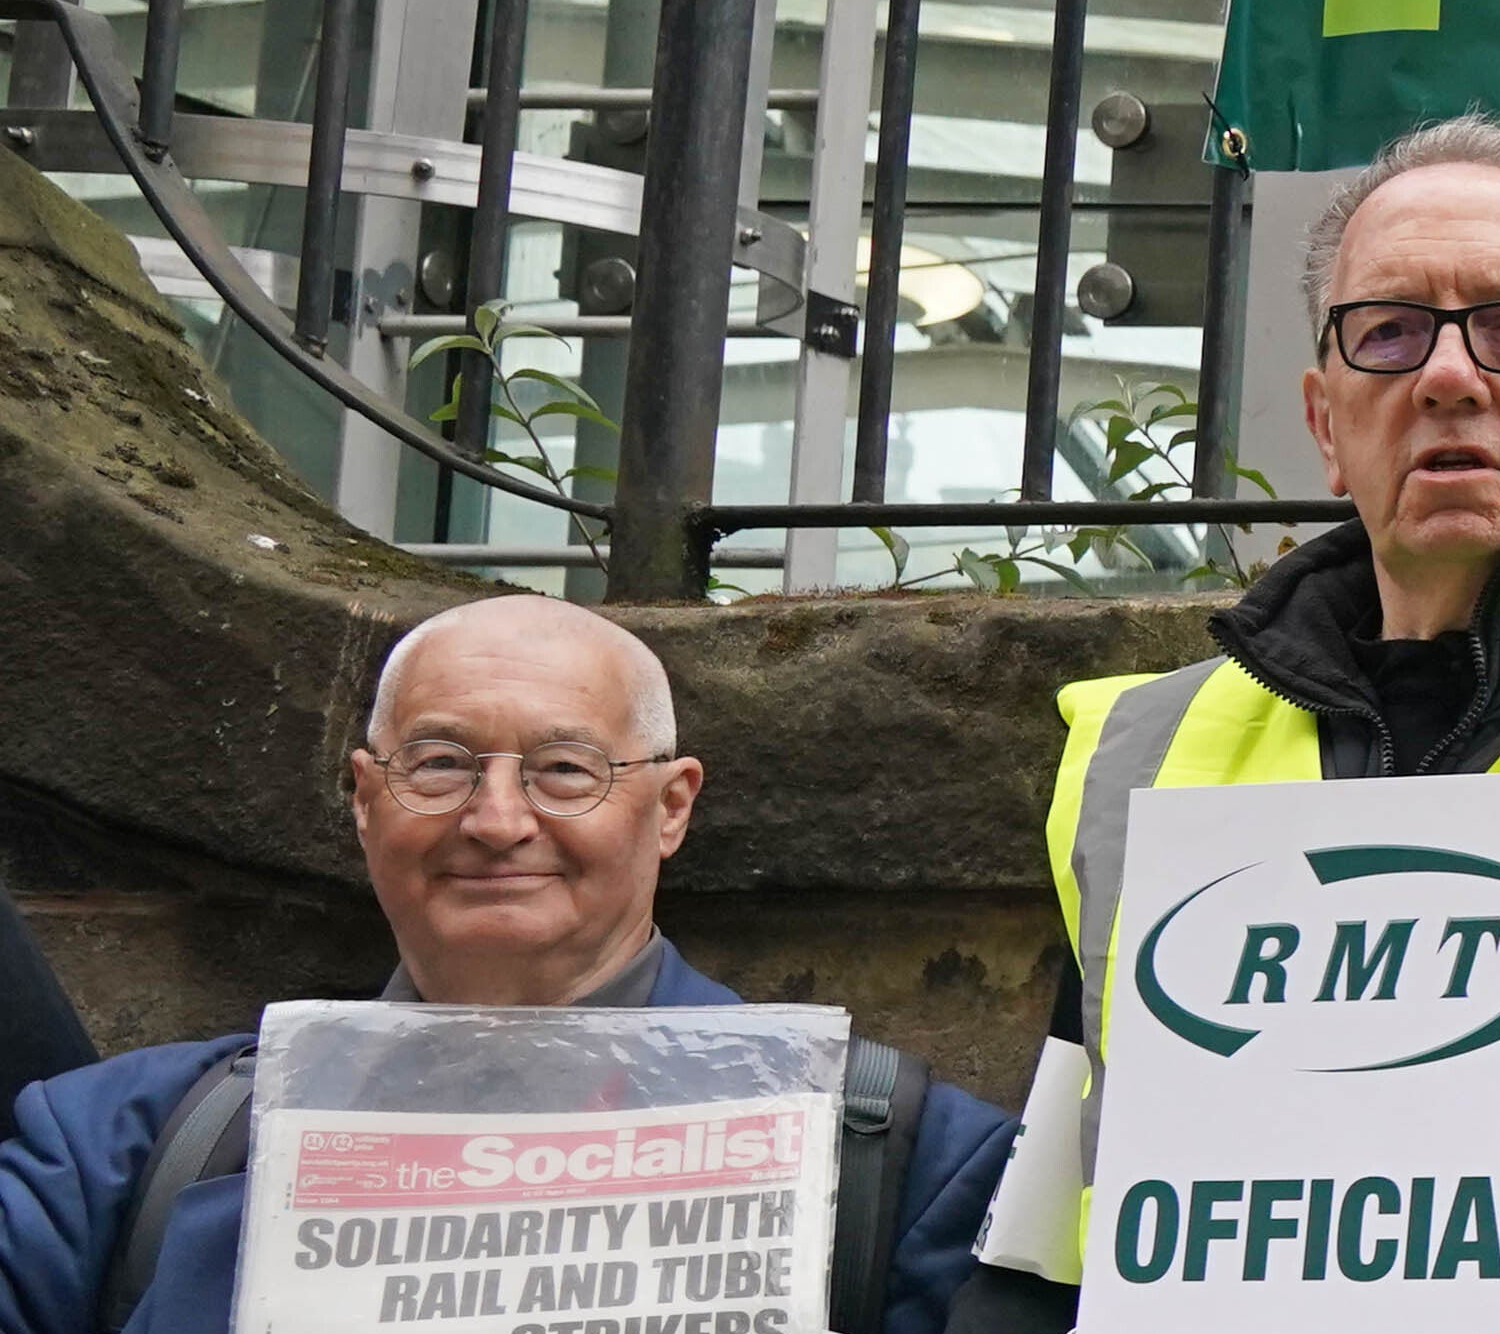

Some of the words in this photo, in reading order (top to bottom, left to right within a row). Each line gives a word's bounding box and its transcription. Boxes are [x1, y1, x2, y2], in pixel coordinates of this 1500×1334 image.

[397, 1161, 455, 1189] the
[457, 1114, 801, 1188] Socialist
[295, 1204, 637, 1270] SOLIDARITY
[647, 1189, 797, 1247] WITH
[379, 1269, 507, 1322] RAIL
[516, 1261, 639, 1313] AND
[652, 1249, 793, 1304] TUBE
